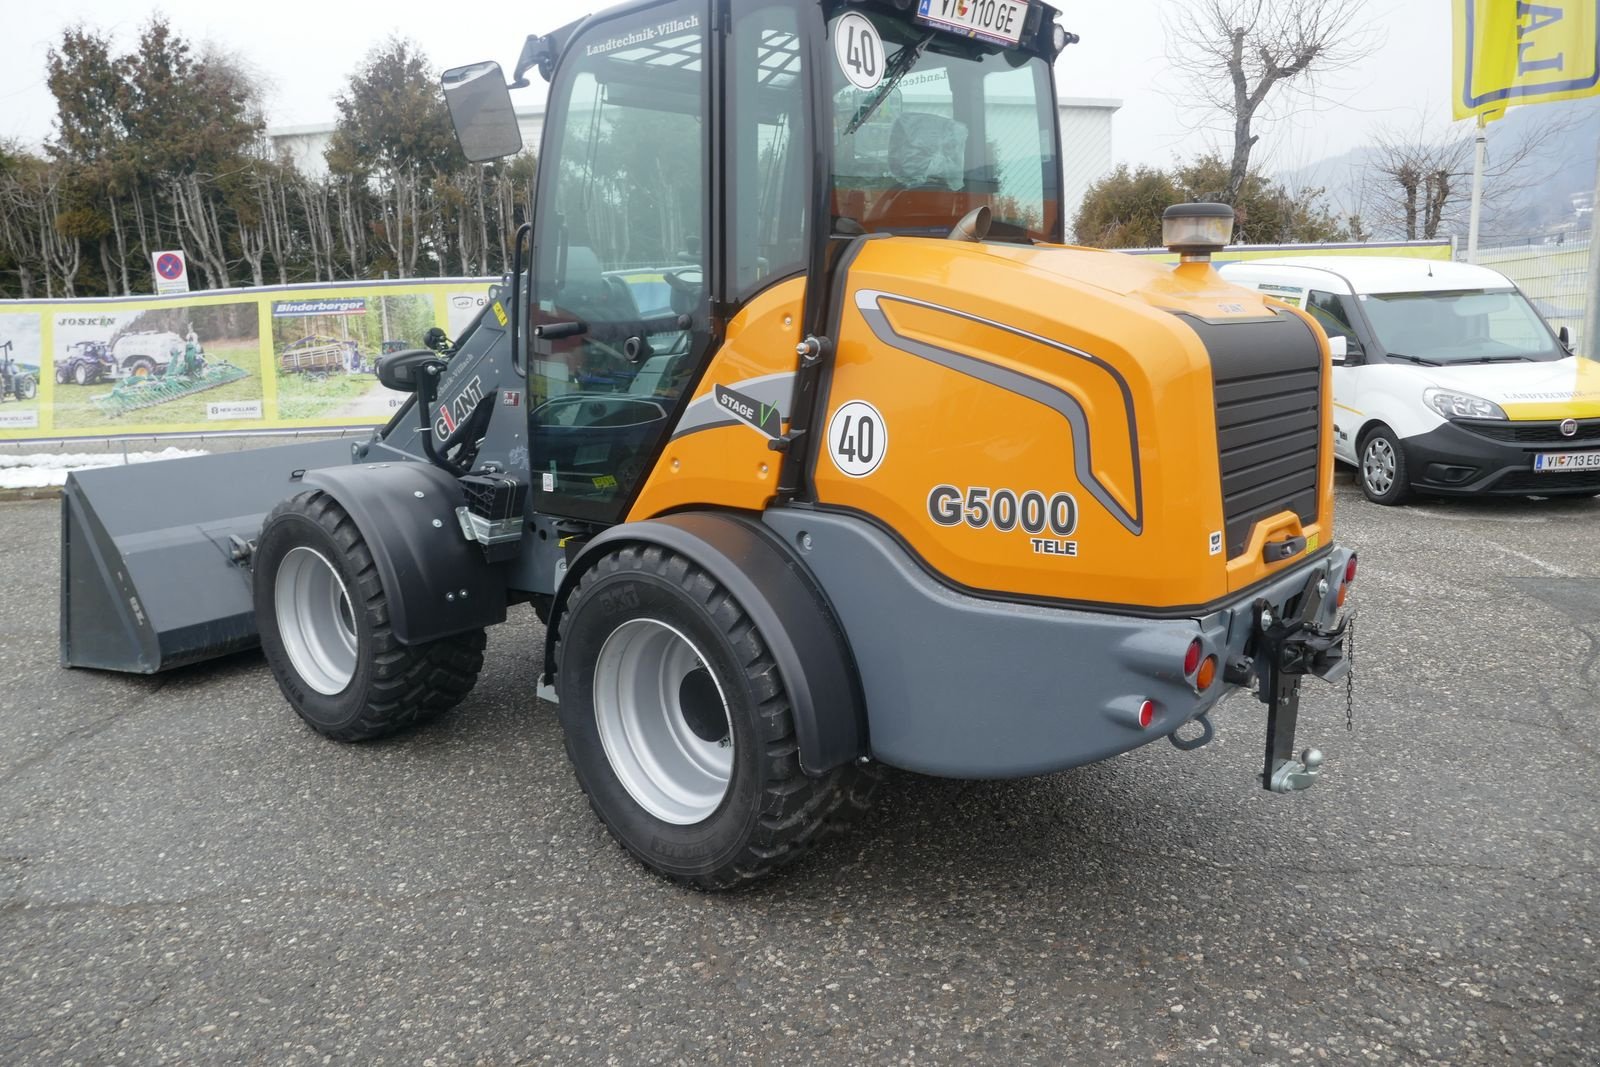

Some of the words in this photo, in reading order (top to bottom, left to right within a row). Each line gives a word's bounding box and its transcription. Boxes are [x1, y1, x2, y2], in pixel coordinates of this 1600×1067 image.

[996, 3, 1017, 34] GE
[587, 15, 699, 56] Landtechnik-Villach
[846, 25, 876, 77] 40
[58, 316, 116, 327] JOSKIN
[276, 301, 364, 313] Binderberger
[720, 393, 755, 420] STAGE
[838, 415, 874, 463] 40
[1547, 456, 1558, 467] VI
[1567, 455, 1585, 467] 713
[1587, 454, 1600, 466] EG
[927, 484, 1078, 537] G5000
[1031, 538, 1078, 557] TELE
